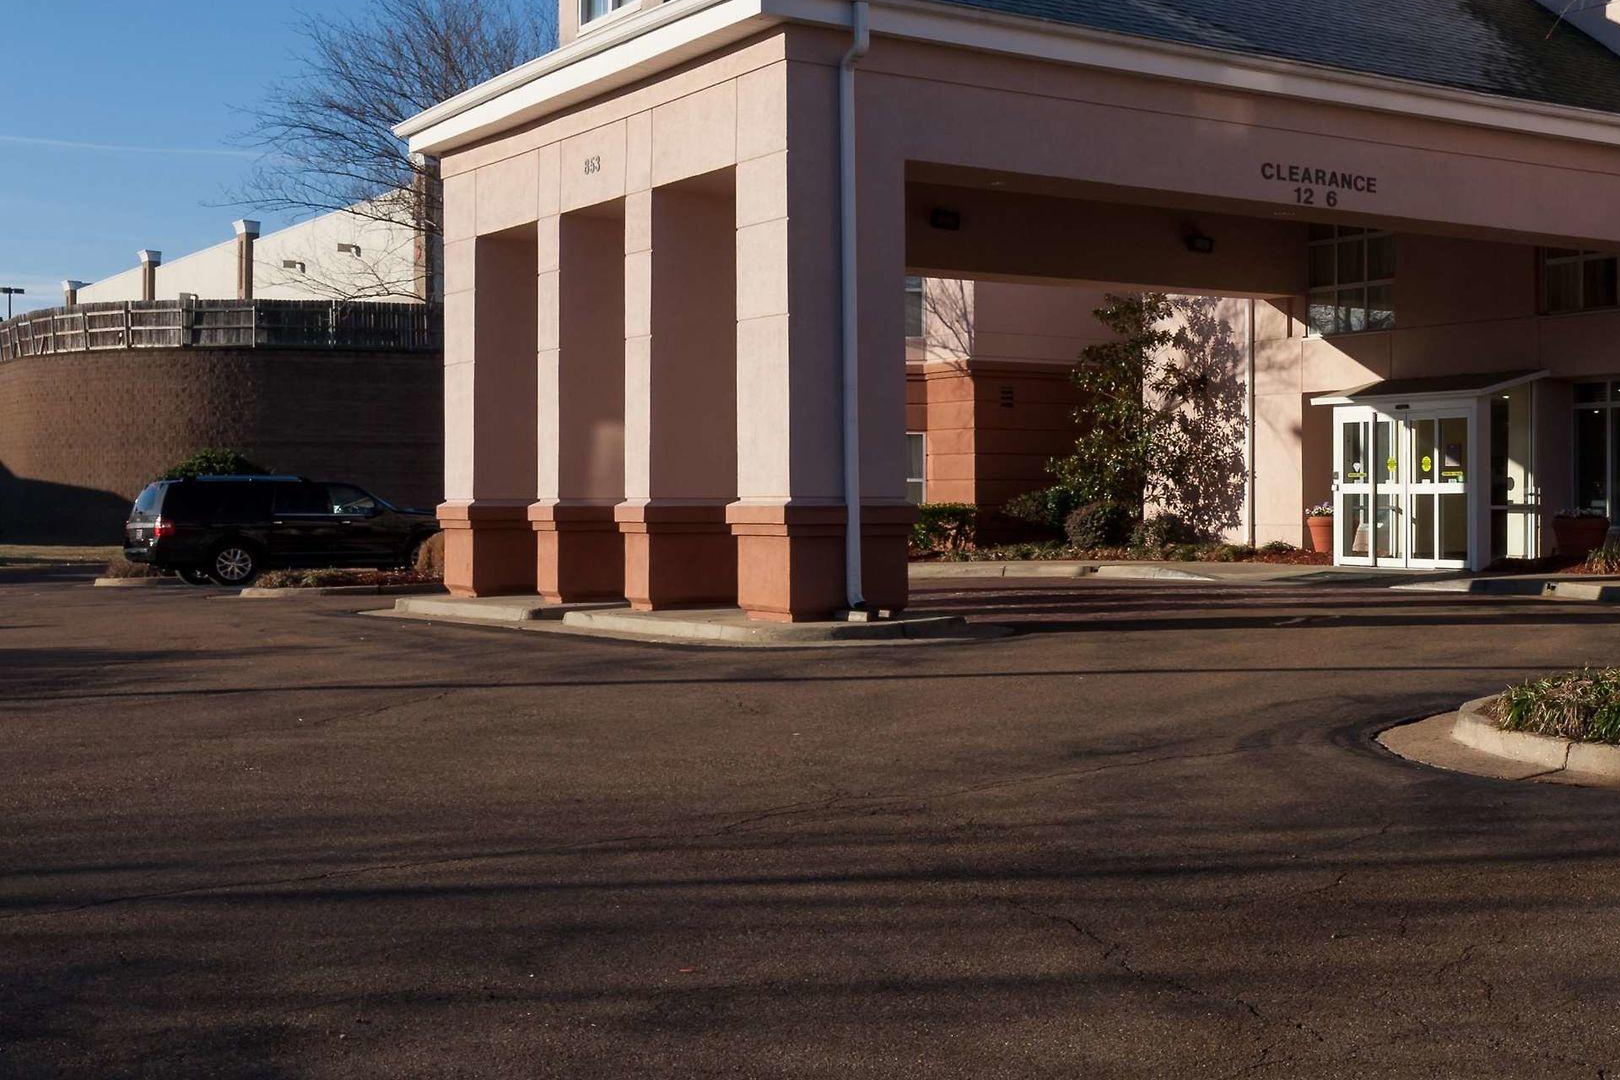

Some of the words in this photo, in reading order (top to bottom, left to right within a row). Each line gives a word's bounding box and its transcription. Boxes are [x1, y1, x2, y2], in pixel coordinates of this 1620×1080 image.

[584, 155, 601, 175] 853
[1261, 162, 1377, 193] CLEARANCE
[1294, 187, 1314, 205] 12
[1326, 190, 1338, 207] 6
